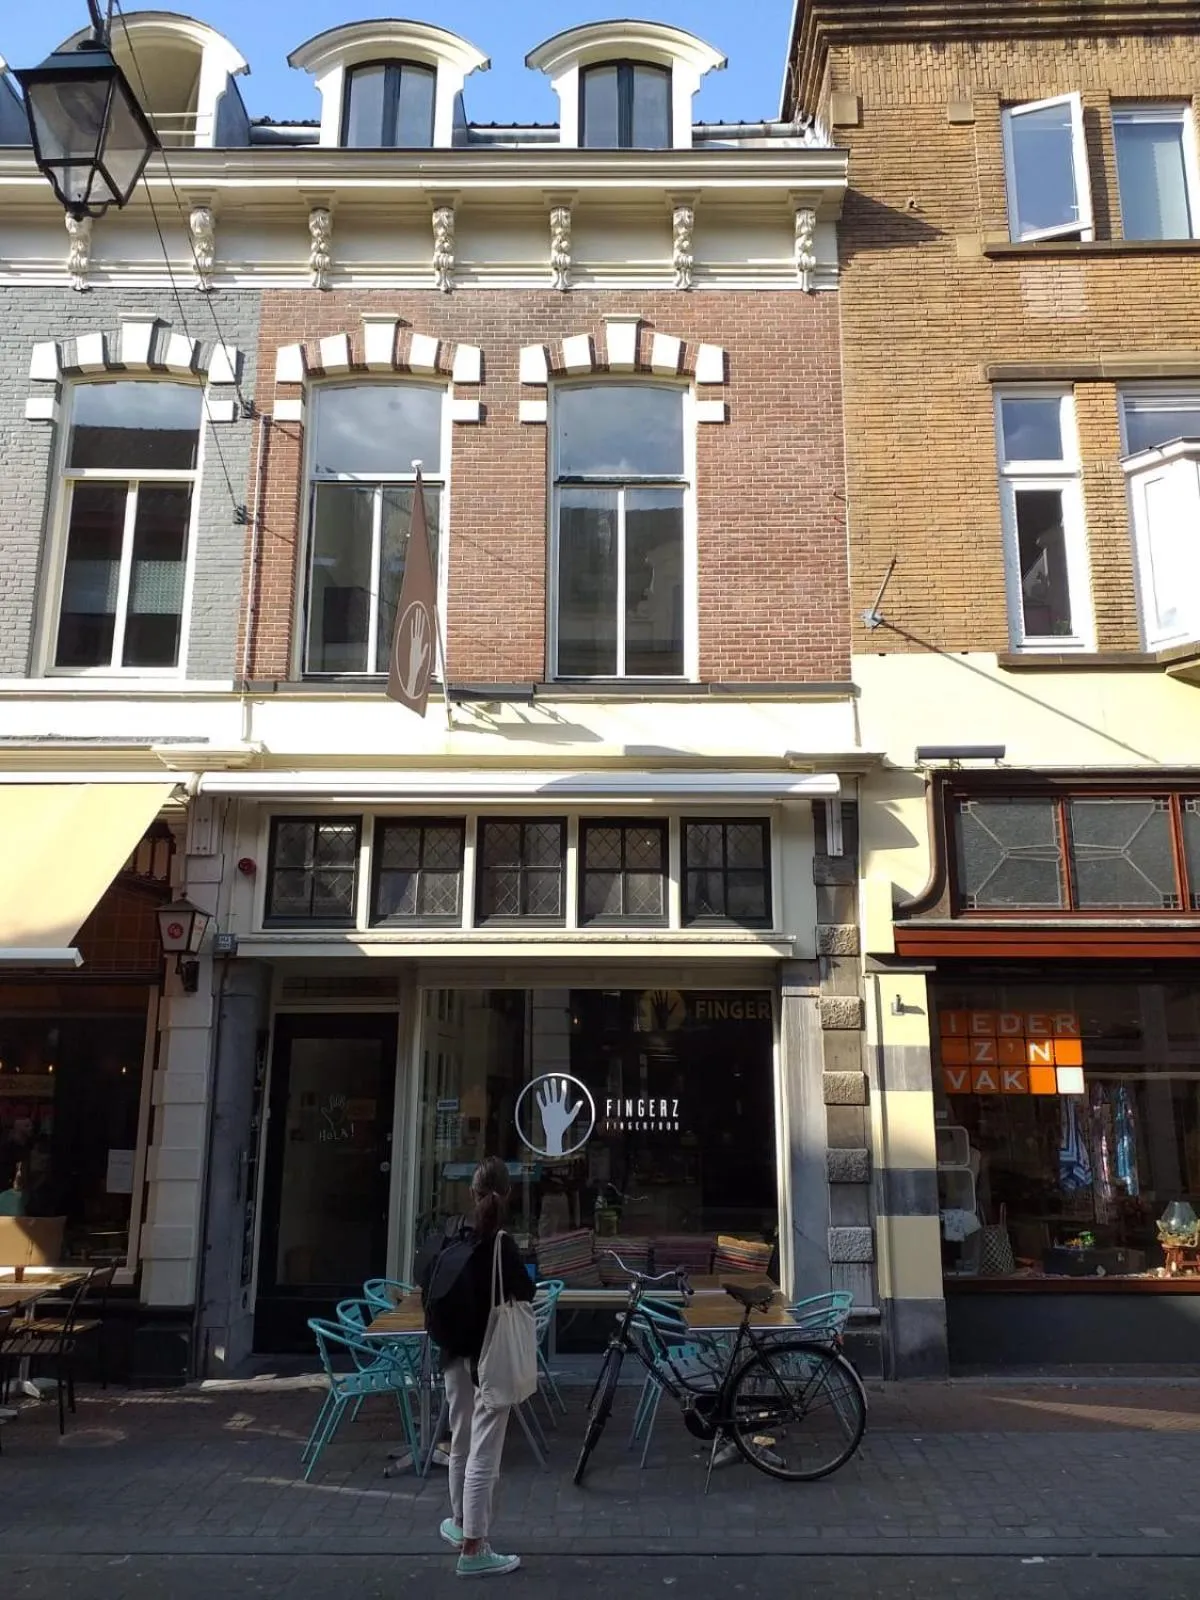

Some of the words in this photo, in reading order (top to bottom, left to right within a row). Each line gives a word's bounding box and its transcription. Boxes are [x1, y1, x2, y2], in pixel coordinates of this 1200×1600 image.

[950, 1013, 1077, 1034] IEDER
[947, 1070, 1025, 1090] VAK
[606, 1099, 679, 1117] FINGERZ
